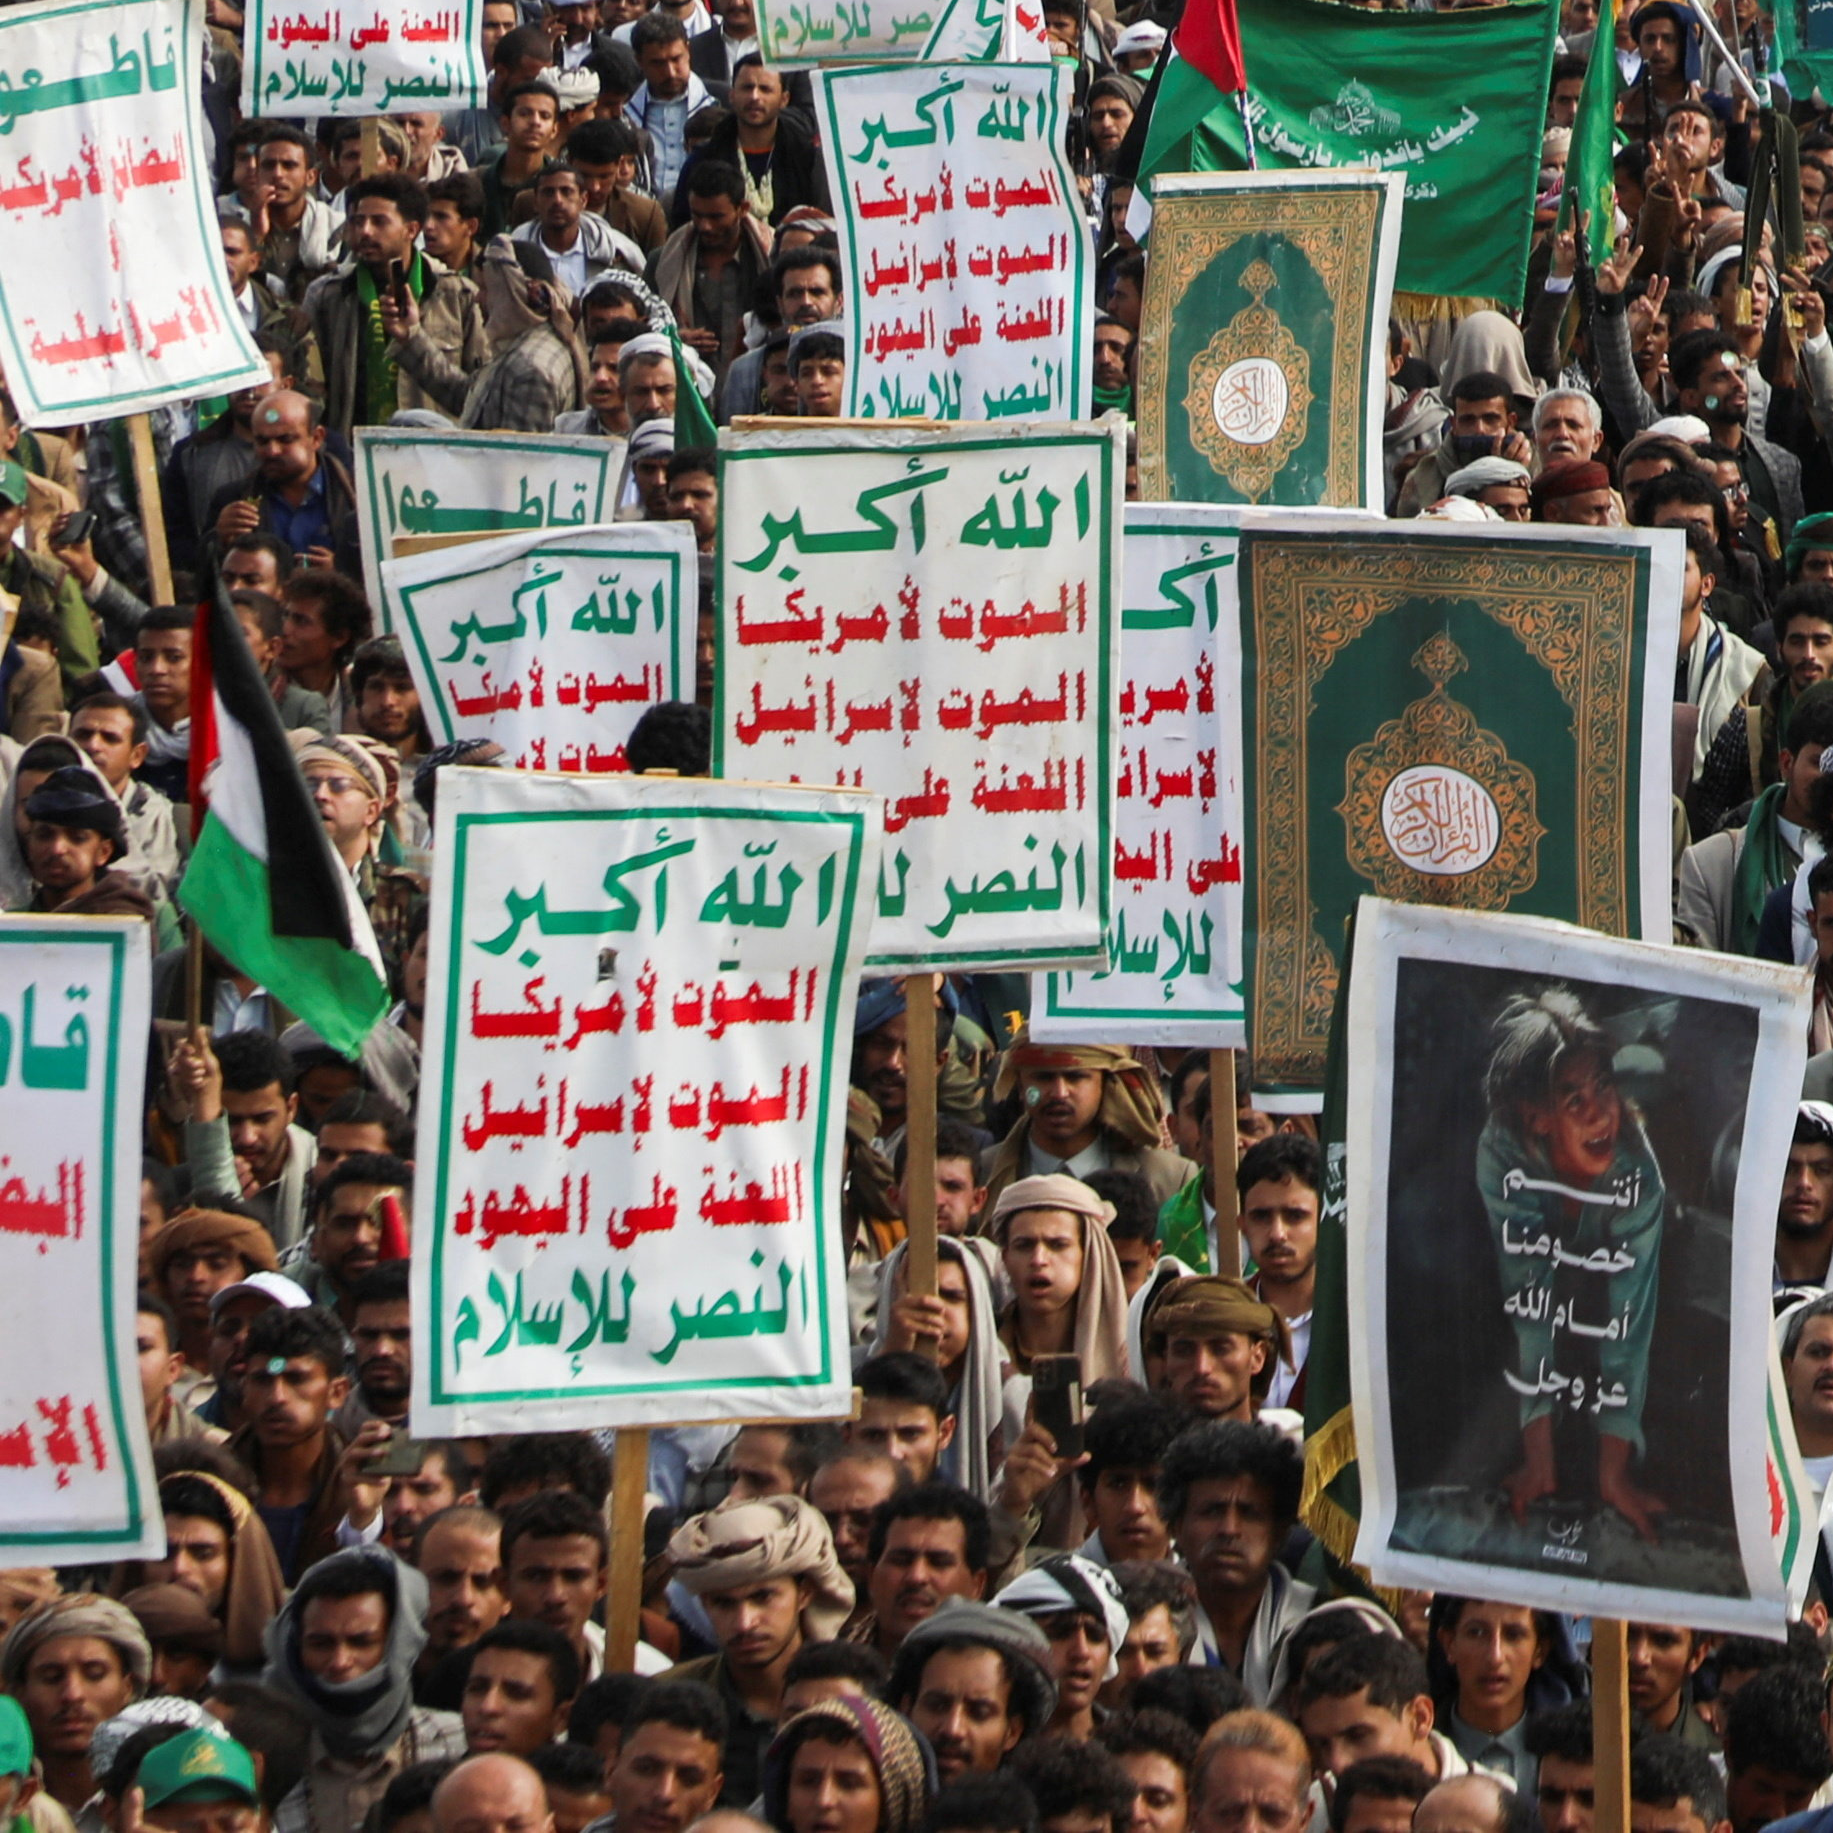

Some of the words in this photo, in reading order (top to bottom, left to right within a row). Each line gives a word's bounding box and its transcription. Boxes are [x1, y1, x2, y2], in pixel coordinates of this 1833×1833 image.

[268, 13, 340, 49] اليهود
[348, 14, 390, 51] على
[402, 14, 459, 43] اللعنة
[265, 61, 371, 110] للإسلام
[375, 64, 462, 110] النصر
[977, 84, 1047, 142] الله
[850, 72, 964, 170] أكبر
[858, 160, 953, 224] لأمريكا
[966, 166, 1058, 216] الموت
[865, 238, 957, 298] لإسرائيل
[969, 235, 1066, 285] الموت
[864, 313, 934, 363] اليهود
[943, 307, 984, 356] على
[991, 299, 1064, 341] اللعنة
[736, 459, 948, 581] أكبر
[960, 470, 1090, 550] الله
[737, 568, 920, 654] لأمريكا
[938, 582, 1086, 651] الموت
[736, 678, 920, 746] لإسرائيل
[938, 672, 1086, 740] الموت
[885, 769, 951, 833] على
[972, 758, 1085, 815] اللعنة
[474, 828, 695, 956] أكبر
[698, 840, 836, 942] الله
[926, 835, 1085, 938] النصر
[472, 951, 657, 1050] لأمريكا
[673, 969, 817, 1040] الموت
[463, 1074, 653, 1155] لإسرائيل
[669, 1066, 808, 1142] الموت
[455, 1175, 589, 1250] اليهود
[608, 1176, 678, 1249] على
[700, 1164, 804, 1229] اللعنة
[1503, 1166, 1641, 1208] أنتم
[1502, 1219, 1637, 1273] خصومنا
[452, 1264, 636, 1377] للإسلام
[651, 1251, 808, 1365] النصر
[1504, 1271, 1551, 1320] الله
[1551, 1298, 1630, 1340] أمام
[1592, 1380, 1629, 1415] عز
